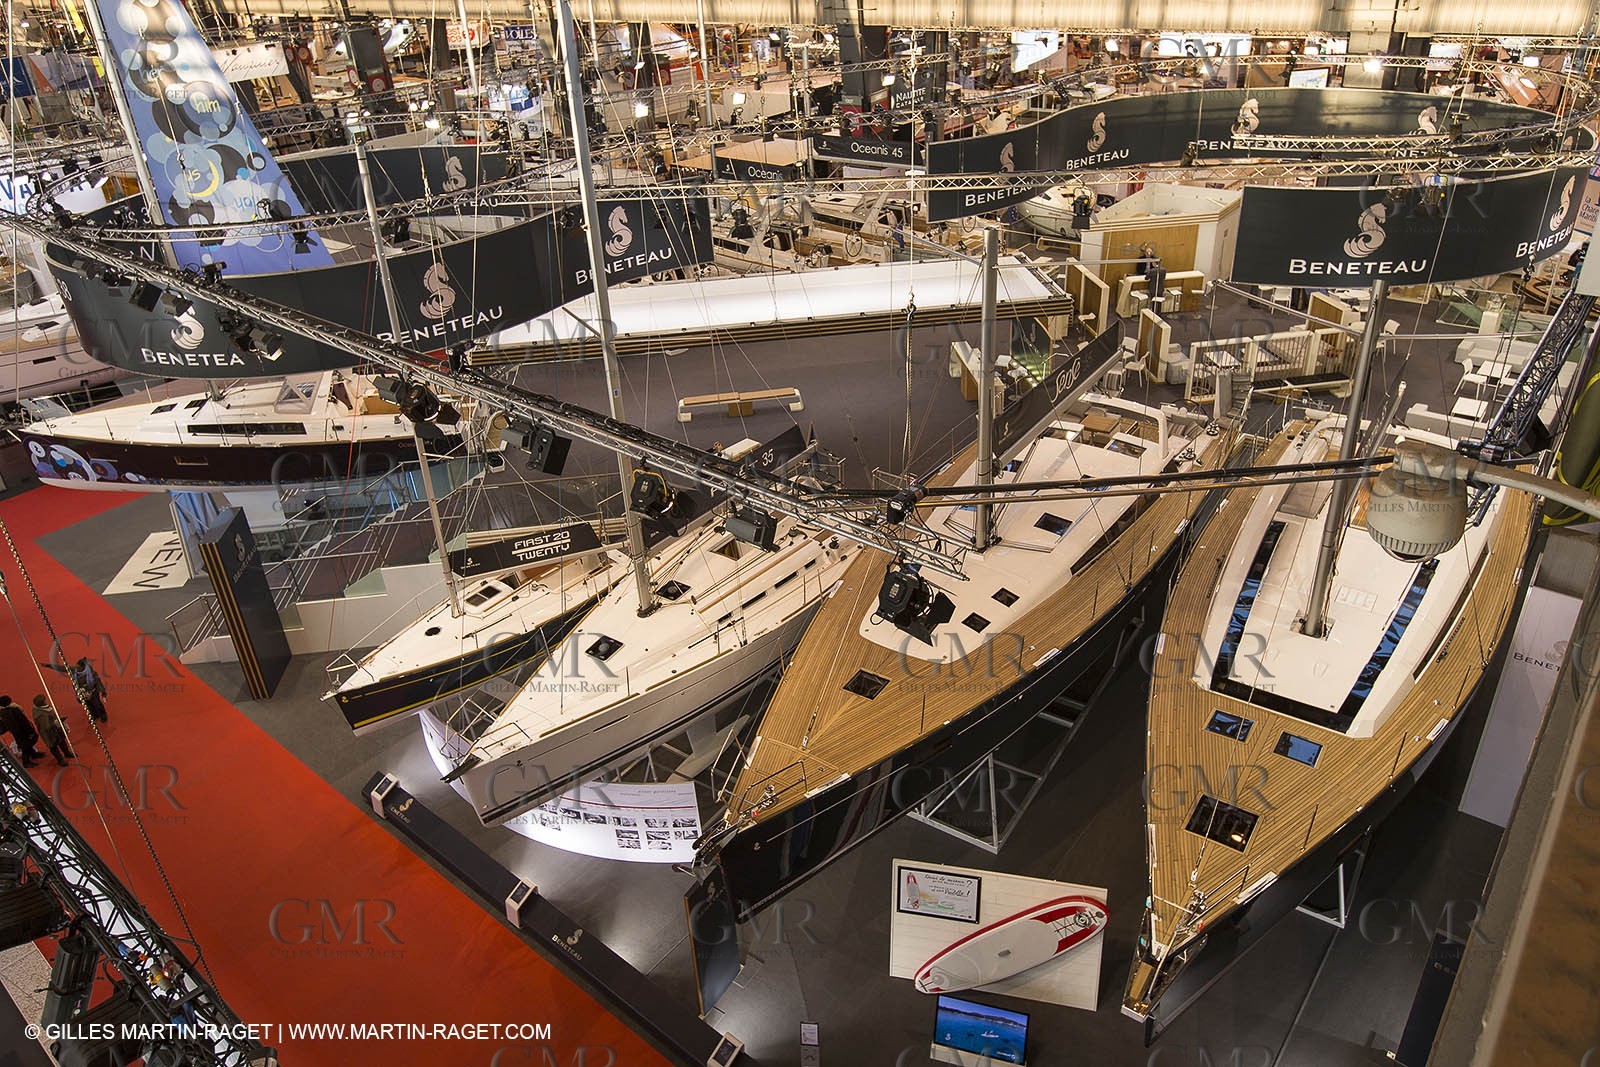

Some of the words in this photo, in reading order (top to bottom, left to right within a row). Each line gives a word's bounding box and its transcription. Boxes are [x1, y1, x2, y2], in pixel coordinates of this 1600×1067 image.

[850, 141, 889, 155] Oceanis
[891, 147, 903, 158] 45
[1066, 148, 1129, 170] BENETEAU
[1288, 258, 1427, 276] BENETEAU
[141, 347, 246, 366] BENETEA
[552, 530, 571, 541] 20
[516, 543, 570, 561] TWENTY
[1513, 651, 1561, 672] BENET
